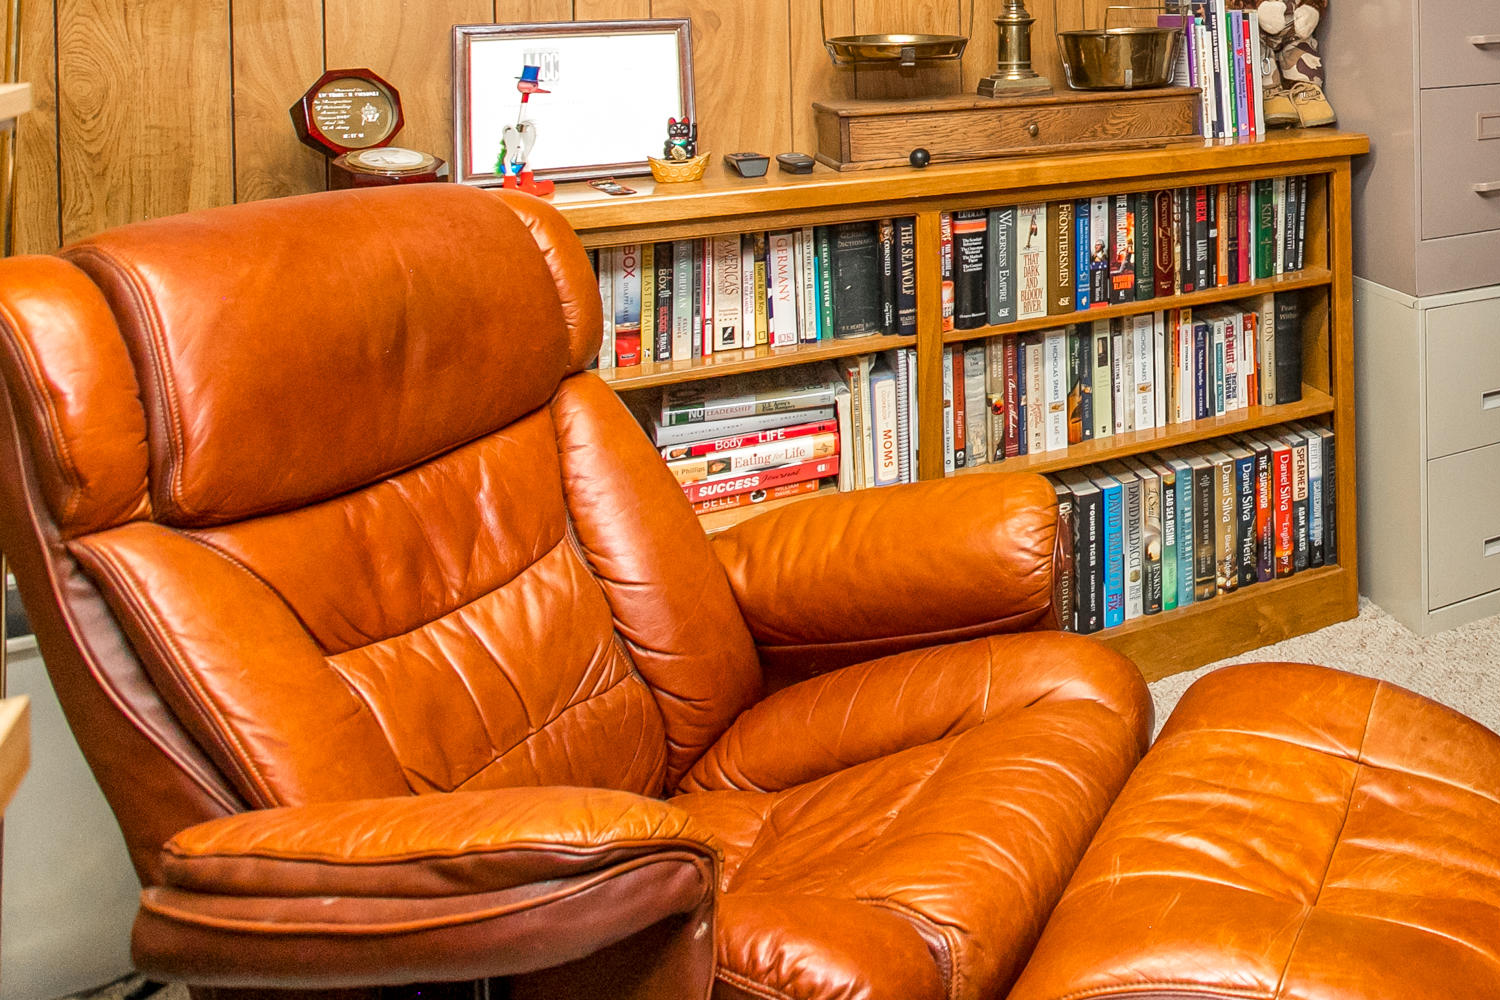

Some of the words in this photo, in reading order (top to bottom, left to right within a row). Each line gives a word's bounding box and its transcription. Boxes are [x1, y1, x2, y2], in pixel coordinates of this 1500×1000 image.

[1141, 205, 1150, 245] INNOCENTS
[1261, 203, 1272, 229] KIM
[900, 225, 913, 246] THE
[999, 210, 1012, 267] WILDERNESS
[1059, 204, 1070, 287] FRONTIERSMEN
[901, 247, 913, 267] SEA
[1196, 239, 1207, 261] LIARS
[658, 268, 668, 290] BOX
[723, 239, 740, 295] AMERICA'S
[776, 238, 790, 302] GERMANY
[644, 274, 652, 297] LAST
[902, 268, 914, 295] WOLF
[999, 270, 1010, 303] EMPIRE
[643, 301, 652, 332] DETAIL
[1264, 311, 1273, 342] LOON
[659, 332, 667, 351] TRAIL
[715, 438, 742, 451] Body
[759, 428, 786, 442] LIFE
[884, 429, 893, 469] MOMS
[682, 465, 706, 475] Phillips
[734, 454, 772, 469] Eating
[785, 447, 806, 460] Life
[1259, 455, 1268, 469] THE
[1279, 454, 1290, 485] Daniel
[1221, 464, 1232, 496] Daniel
[1242, 463, 1252, 494] Daniel
[1295, 448, 1306, 499] SPEARHEAD
[699, 476, 760, 498] SUCCESS
[1166, 489, 1174, 504] DEAD
[1259, 471, 1268, 508] SURVIVOR
[1280, 487, 1291, 511] Silva
[1108, 493, 1121, 529] DAVID
[1127, 486, 1140, 518] DAVID
[1166, 505, 1174, 519] SEA
[1222, 497, 1233, 522] Silva
[1242, 496, 1253, 520] Silva
[1128, 519, 1140, 568] BALDACCI
[1166, 520, 1174, 545] RISING
[1223, 534, 1232, 552] Black
[1280, 522, 1291, 549] English
[1243, 537, 1253, 565] Heist
[1280, 551, 1290, 565] Spy
[1151, 563, 1161, 599] JENKINS
[1108, 594, 1118, 611] FIX
